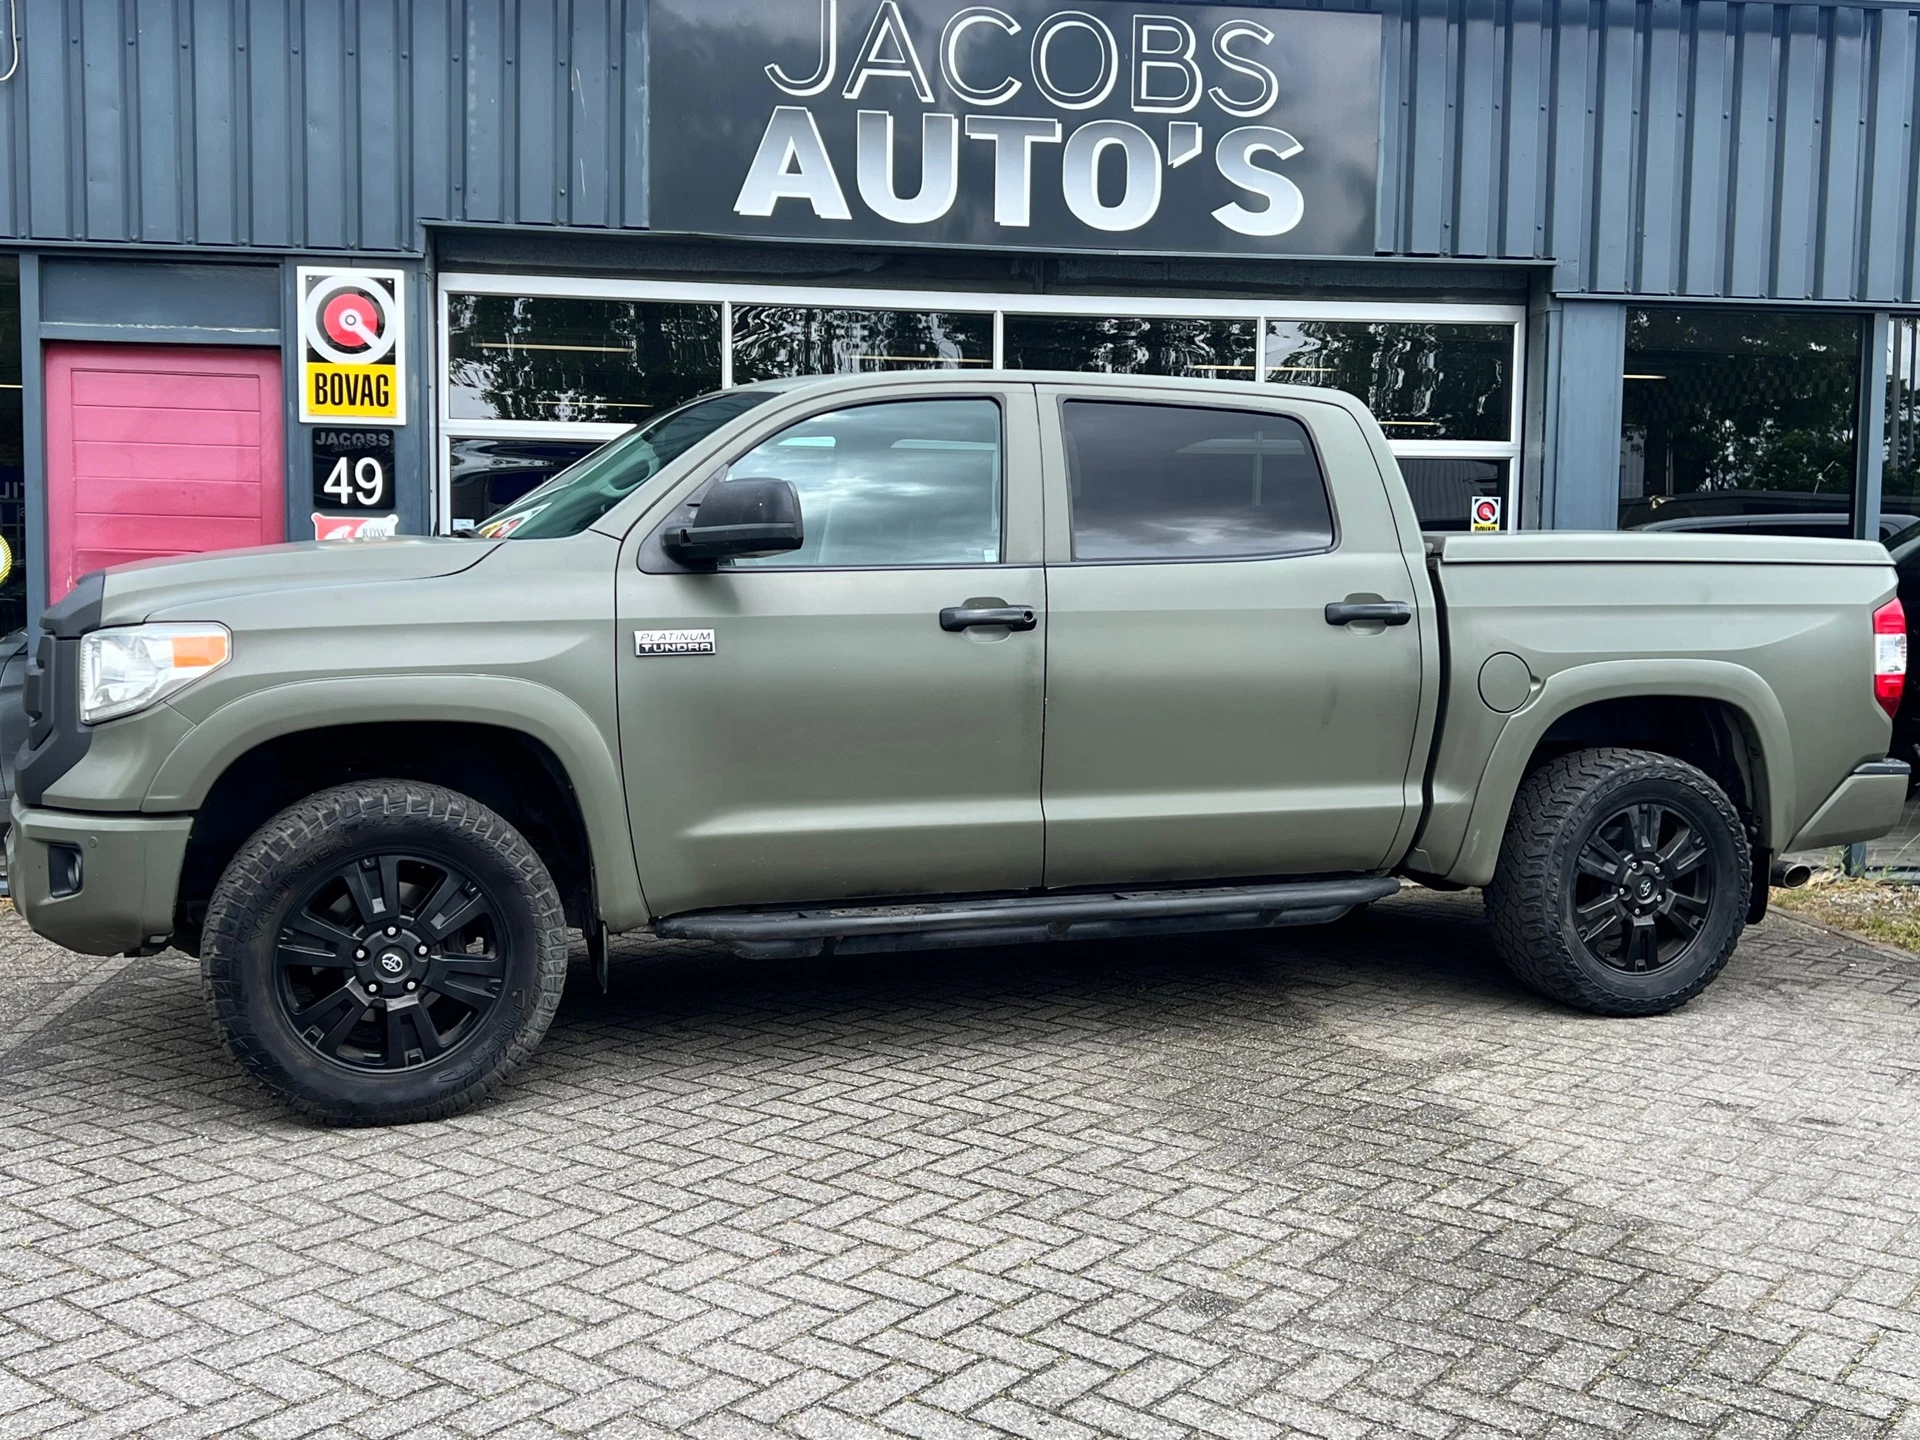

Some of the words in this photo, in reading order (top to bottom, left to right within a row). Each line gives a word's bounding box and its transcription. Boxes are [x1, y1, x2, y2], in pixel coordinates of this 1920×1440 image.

[764, 0, 1279, 117] JACOBS
[733, 106, 1304, 236] AUTO'S
[314, 372, 389, 407] BOVAG
[315, 431, 390, 446] JACOBS
[323, 456, 383, 506] 49
[640, 632, 711, 642] PLATINUM
[641, 643, 711, 653] TUNDRA
